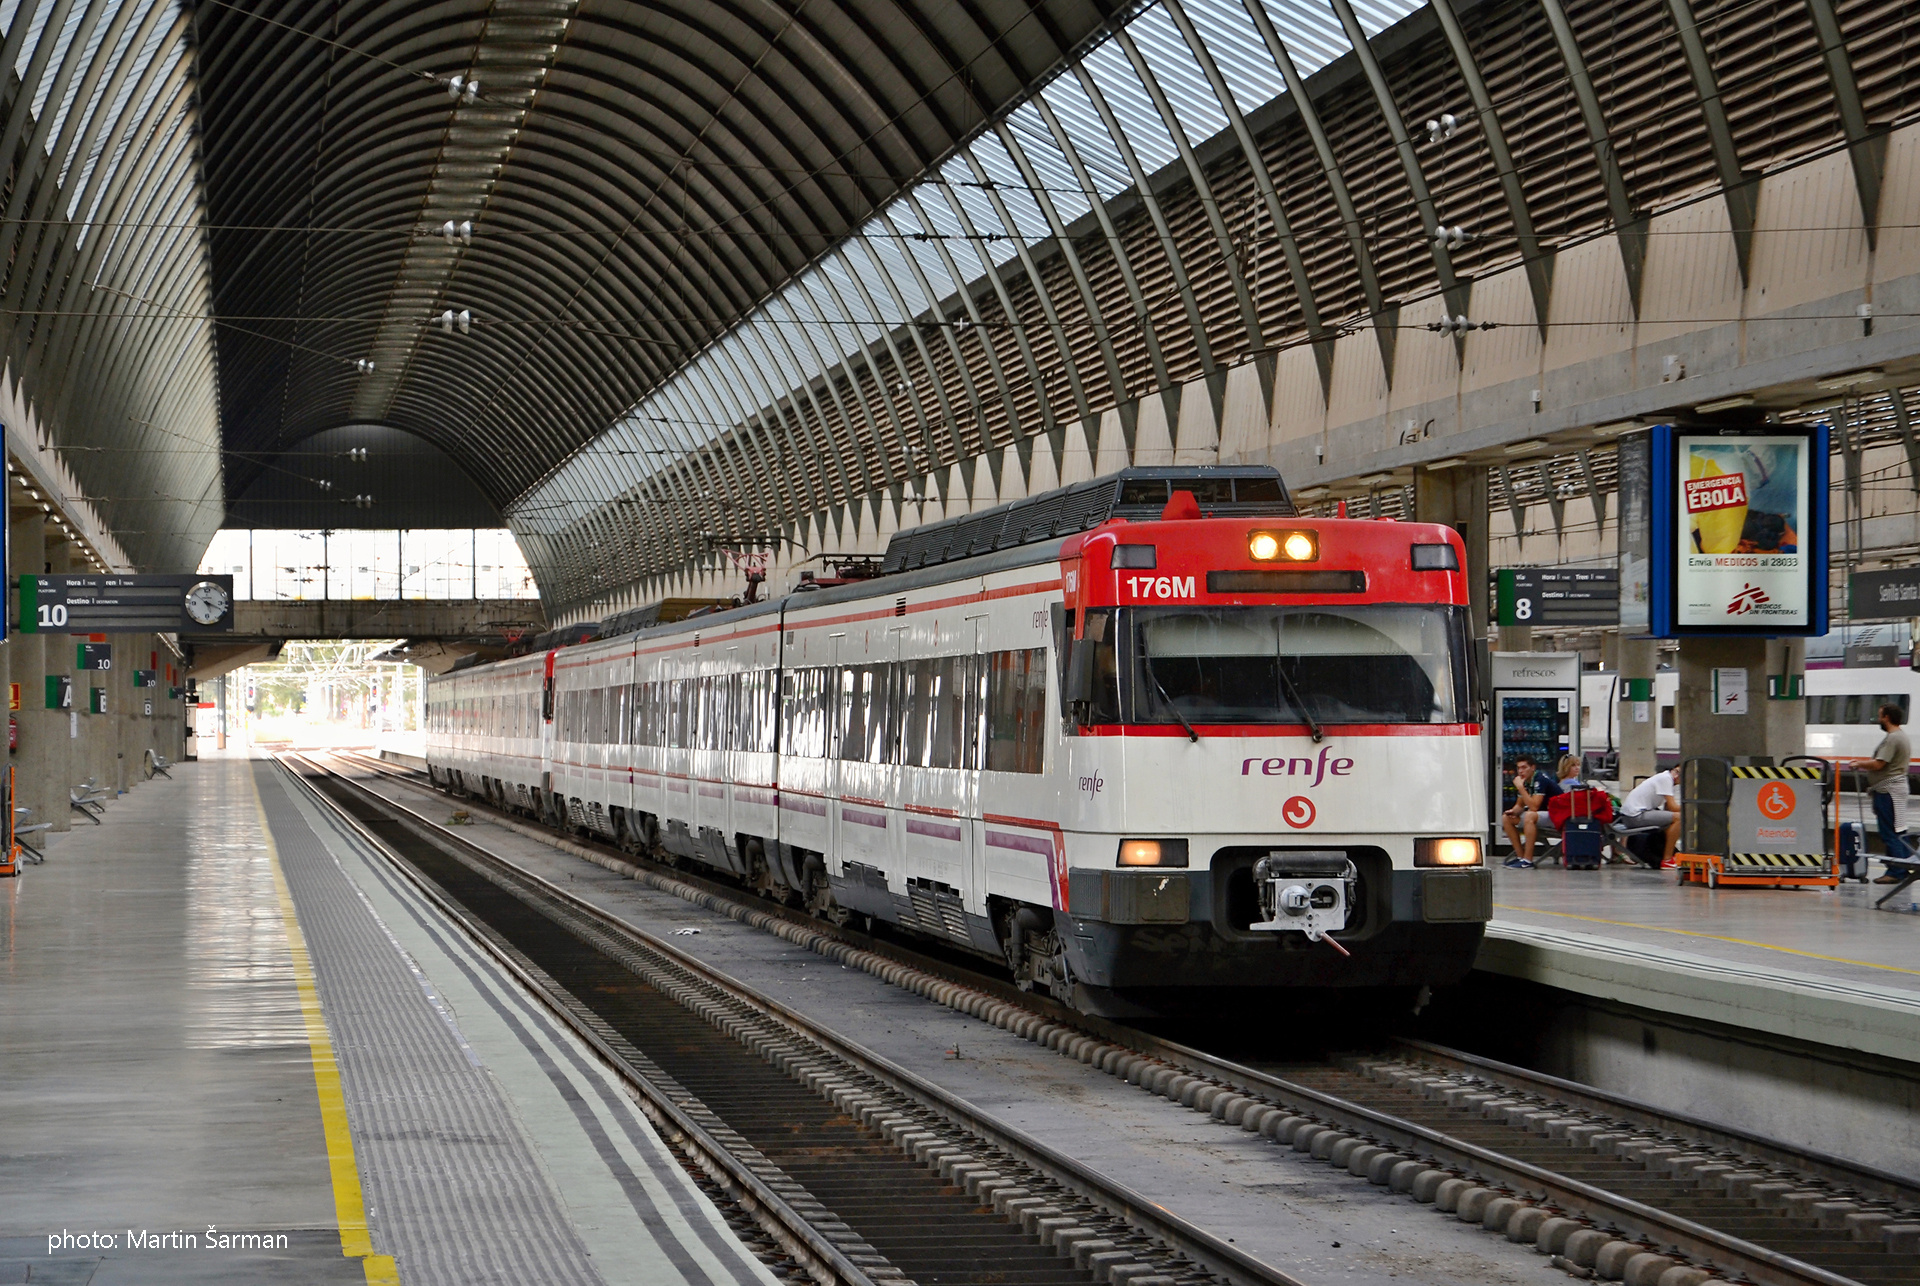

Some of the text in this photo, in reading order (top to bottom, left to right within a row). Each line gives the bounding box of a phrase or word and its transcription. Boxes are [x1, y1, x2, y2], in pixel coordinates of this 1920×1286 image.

[1686, 475, 1742, 491] EMERGENCIA
[1688, 486, 1745, 509] ÉBOLA
[1688, 557, 1798, 567] Envía MEDICOS al 28033
[38, 579, 49, 587] Vía
[66, 579, 81, 587] Hora
[1127, 576, 1196, 599] 176M
[38, 604, 68, 627] 10
[1516, 598, 1532, 619] 8
[1032, 598, 1049, 640] renfe
[97, 659, 110, 670] 10
[1512, 667, 1556, 678] refrescos
[147, 680, 156, 688] 10
[1621, 682, 1630, 698] J
[62, 685, 72, 707] A
[145, 704, 151, 715] B
[1241, 746, 1354, 788] renfe
[1078, 768, 1104, 801] renfe
[1756, 828, 1797, 839] Atendo
